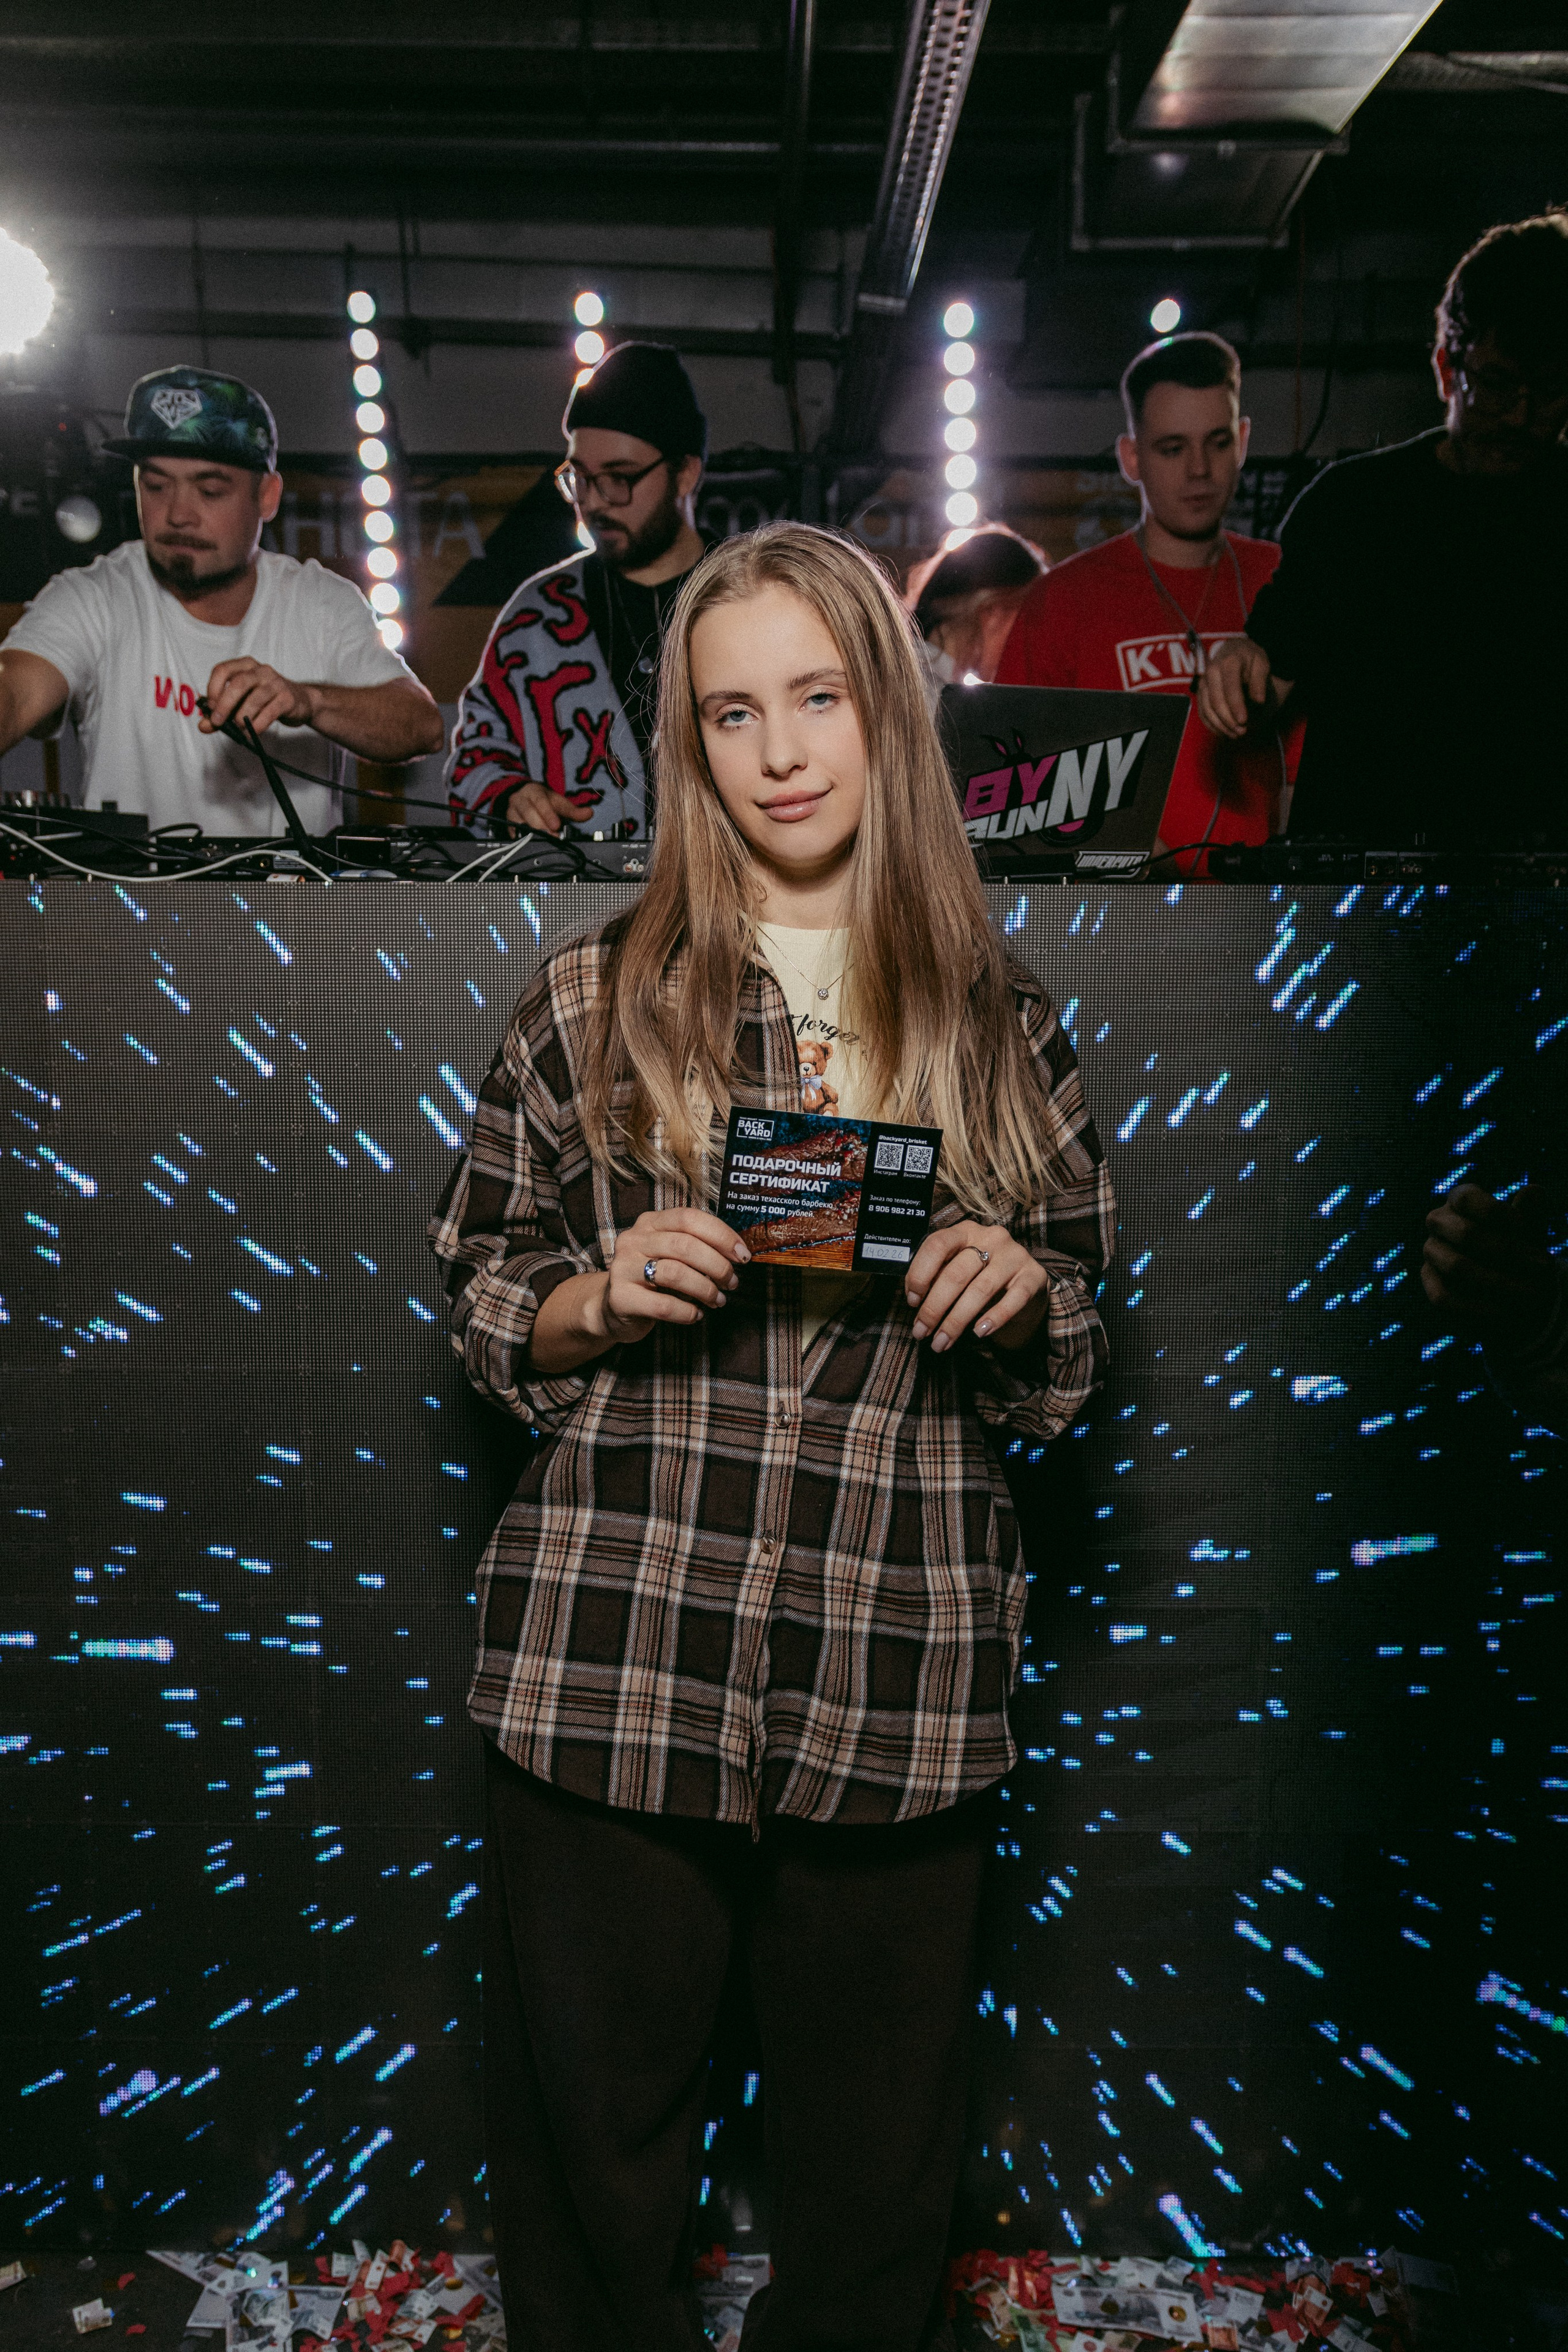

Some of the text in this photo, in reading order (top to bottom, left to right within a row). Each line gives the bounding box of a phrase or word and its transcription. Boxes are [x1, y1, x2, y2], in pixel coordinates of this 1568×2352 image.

[737, 1119, 765, 1129] BACK
[744, 1128, 771, 1137] YARD
[878, 1134, 928, 1145] @backyard_brisket
[731, 1154, 842, 1177] ПОДАРОЧНЫЙ
[729, 1172, 831, 1193] СЕРТИФИКАТ
[739, 1193, 760, 1201] заказ
[761, 1195, 800, 1206] техасского
[801, 1198, 833, 1209] барбекю
[737, 1204, 760, 1213] сумму
[768, 1206, 786, 1215] 000
[787, 1209, 815, 1218] рублей.
[864, 1233, 901, 1243] Действителен
